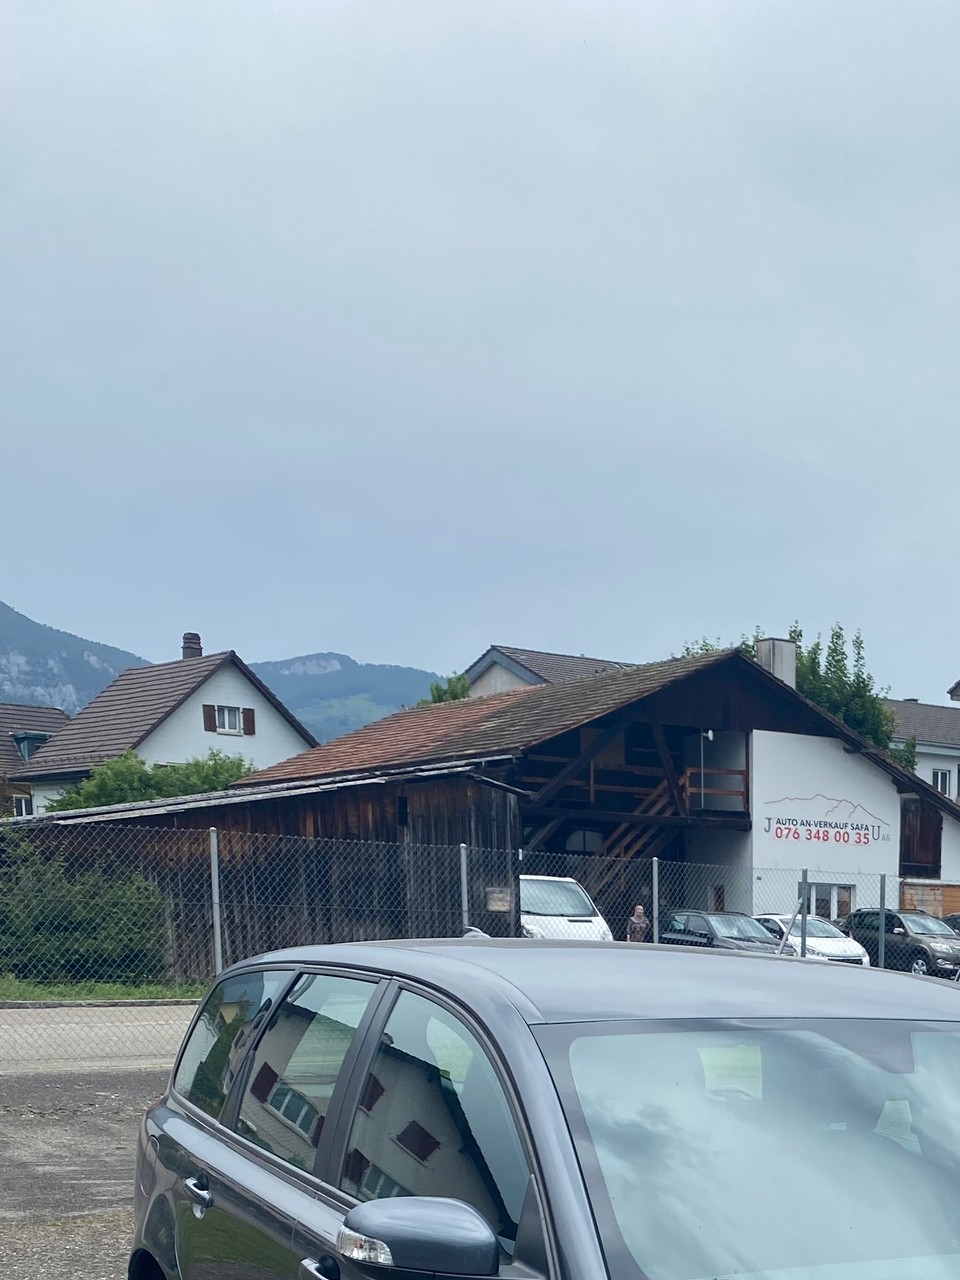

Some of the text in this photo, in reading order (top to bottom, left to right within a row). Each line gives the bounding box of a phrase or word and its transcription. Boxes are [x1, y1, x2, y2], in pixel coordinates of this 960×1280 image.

[776, 818, 870, 832] AUTO AN-VERKAUF SAFA
[775, 827, 870, 845] 076 348 00 35
